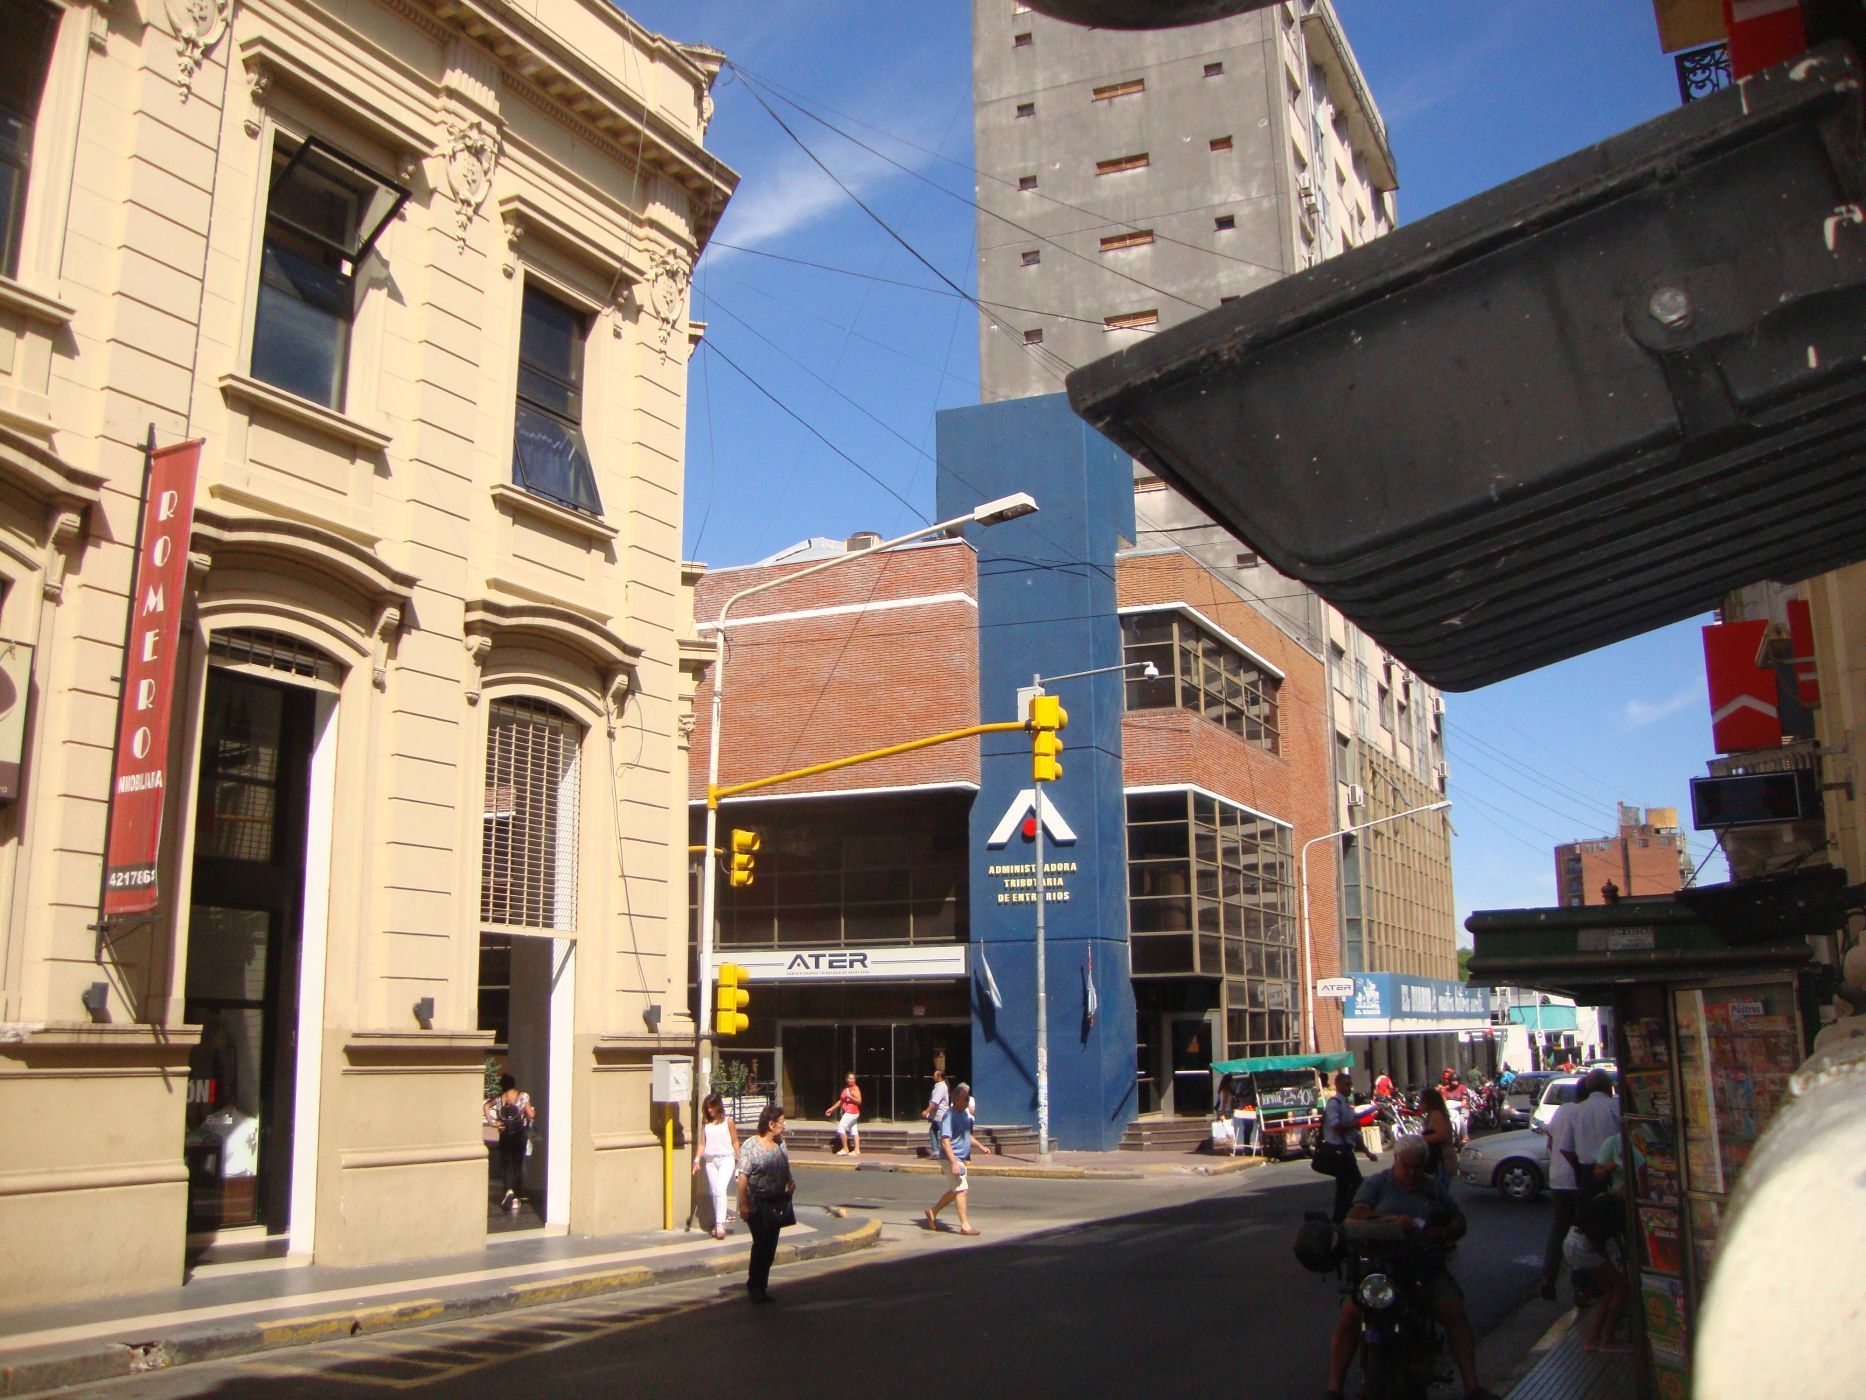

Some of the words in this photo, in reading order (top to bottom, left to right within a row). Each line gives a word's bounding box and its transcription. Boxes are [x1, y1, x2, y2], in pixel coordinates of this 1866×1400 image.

[133, 490, 178, 759] ROMERO
[989, 863, 1077, 874] ADMINISTADORA
[997, 893, 1010, 902] DE
[1012, 891, 1037, 902] ENTR
[1046, 891, 1070, 901] RIOS
[787, 952, 868, 970] ATER
